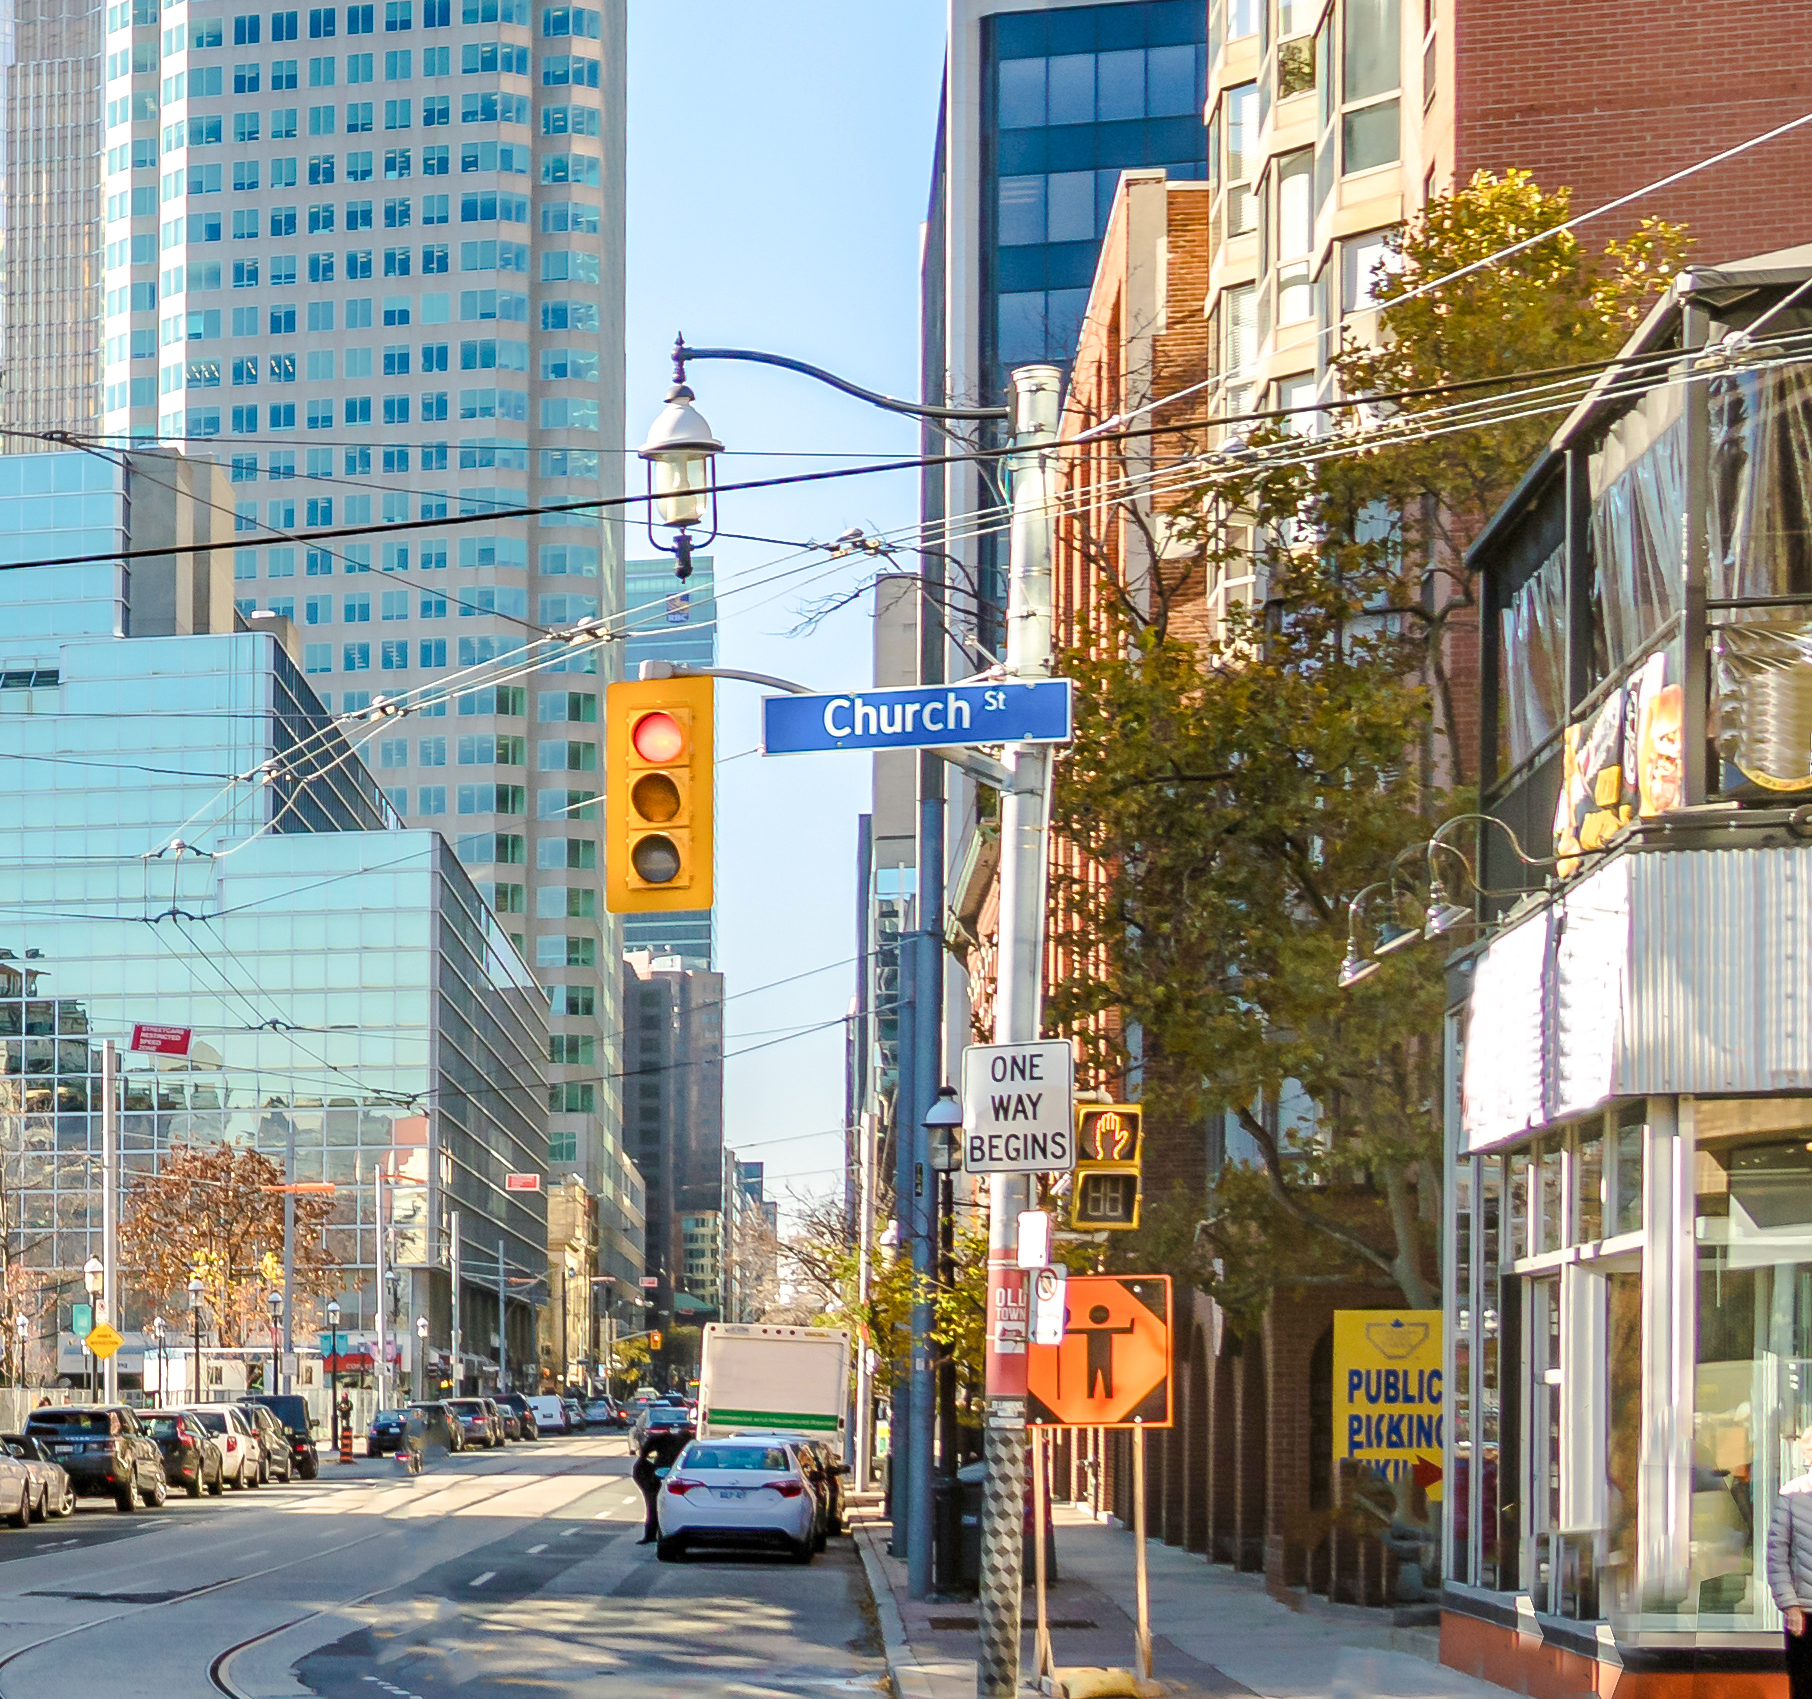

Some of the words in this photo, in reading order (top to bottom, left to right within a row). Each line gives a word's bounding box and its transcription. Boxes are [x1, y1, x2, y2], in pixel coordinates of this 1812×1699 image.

[823, 692, 971, 738] Church
[985, 690, 1007, 711] St
[990, 1053, 1044, 1083] ONE
[991, 1092, 1043, 1123] WAY
[969, 1131, 1067, 1163] BEGINS
[995, 1287, 1026, 1307] OLD
[996, 1307, 1026, 1321] TOWN
[1347, 1368, 1443, 1404] PUBLIC
